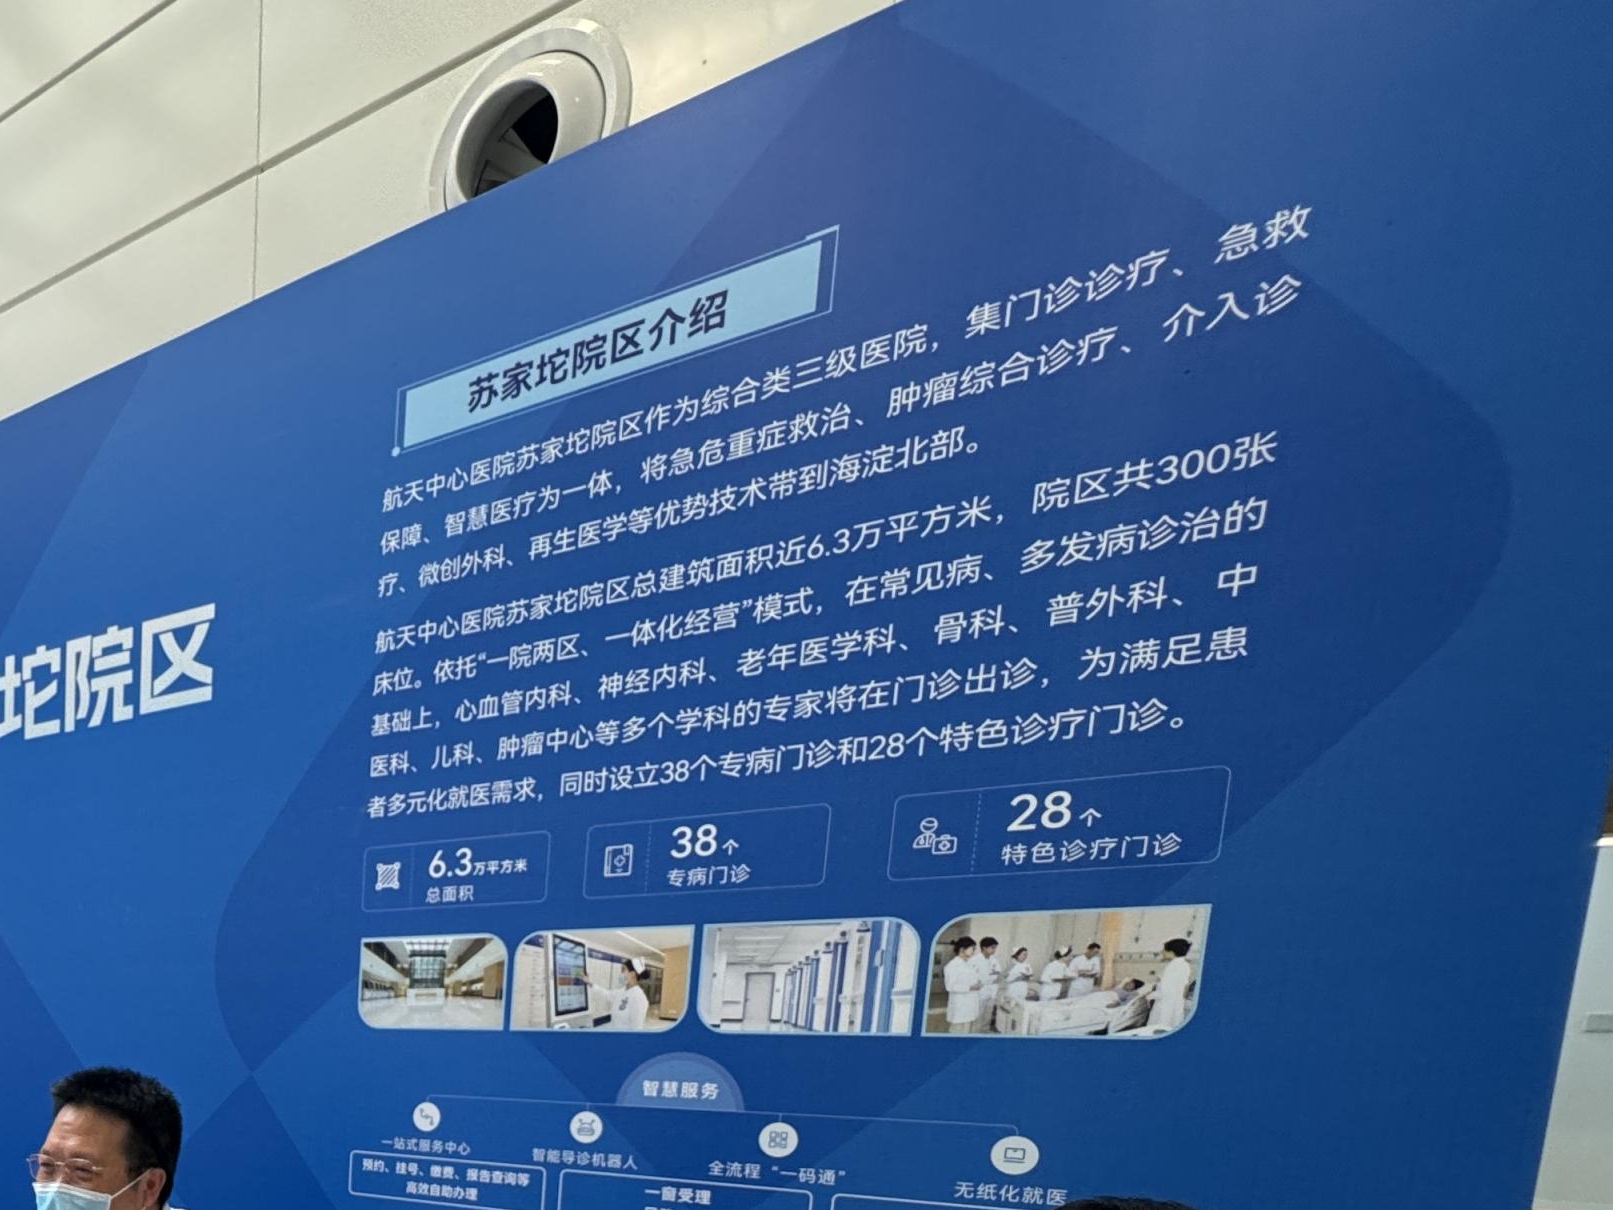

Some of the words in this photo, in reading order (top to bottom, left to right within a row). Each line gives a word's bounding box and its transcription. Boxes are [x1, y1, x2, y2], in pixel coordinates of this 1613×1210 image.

[382, 204, 1313, 513] 航天中心医院苏家坨院区作为综合类三级医院，集门诊诊疗、急救
[467, 289, 729, 413] 苏家坨院区介绍
[379, 273, 1303, 555] 保障、智慧医疗为一体，将急危重症救治、肿瘤综合诊疗、介入诊
[377, 425, 980, 598] 疗、微创外科、再生医学等优势技术带到海淀北部。
[373, 430, 1279, 654] 航天中心医院苏家坨院区总建筑面积近6.3万平方米，院区共300张
[370, 562, 1259, 737] 基础上，心血管内科、神经内科、老年医学科、骨科、普外科、中
[369, 625, 1249, 779] 医科、儿科、肿瘤中心等多个学科的专家将在门诊出诊，为满足患
[366, 697, 1186, 819] 者多元化就医需求，同时设立38个专病门诊和28个特色诊疗门诊。
[427, 846, 529, 879] 6.3万平方米
[1000, 832, 1184, 867] 特色诊疗门诊
[424, 883, 475, 905] 总面积
[666, 864, 752, 889] 专病门诊
[641, 1079, 720, 1102] 智慧服务
[381, 1136, 472, 1156] 一站式服务中心
[531, 1147, 639, 1171] 智能导诊机器人
[405, 1180, 479, 1202] 高效自助办理
[953, 1181, 1069, 1206] 无纸化就医
